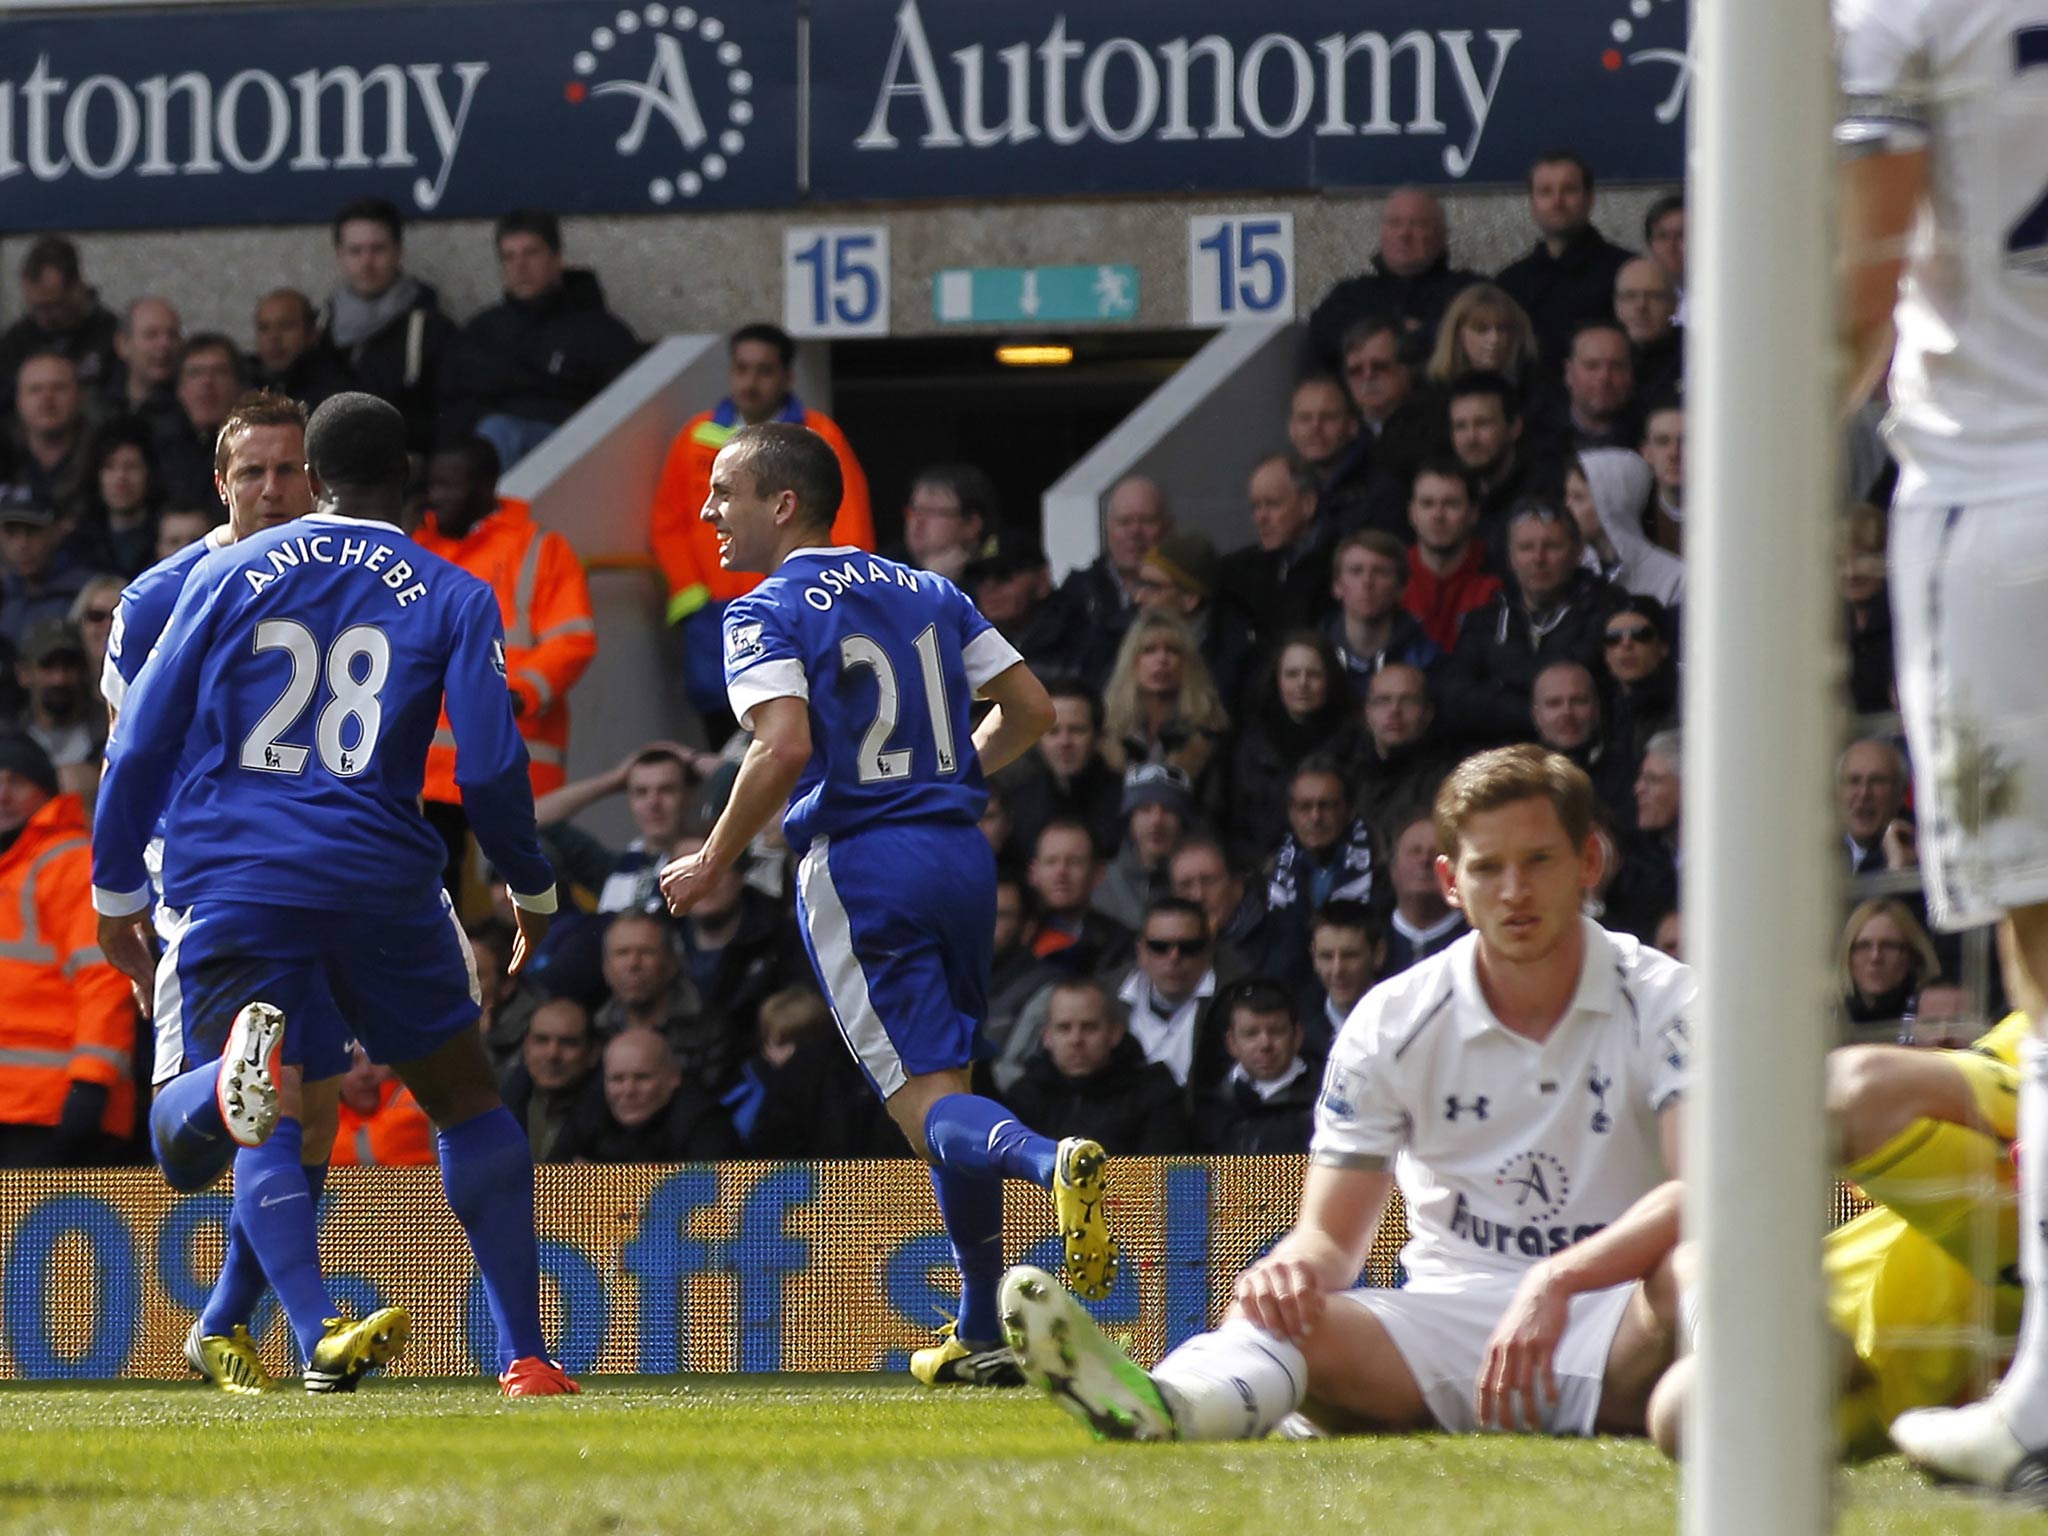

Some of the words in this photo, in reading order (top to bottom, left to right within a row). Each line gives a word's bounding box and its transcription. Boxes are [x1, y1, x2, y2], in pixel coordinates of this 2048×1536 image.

[854, 0, 1522, 178] Autonomy
[795, 236, 880, 327] 15
[1200, 220, 1286, 313] 15
[244, 535, 427, 607] ANICHEBE
[804, 561, 919, 612] OSMAN
[240, 618, 391, 778] 28
[840, 622, 957, 784] 21
[463, 1167, 816, 1376] off
